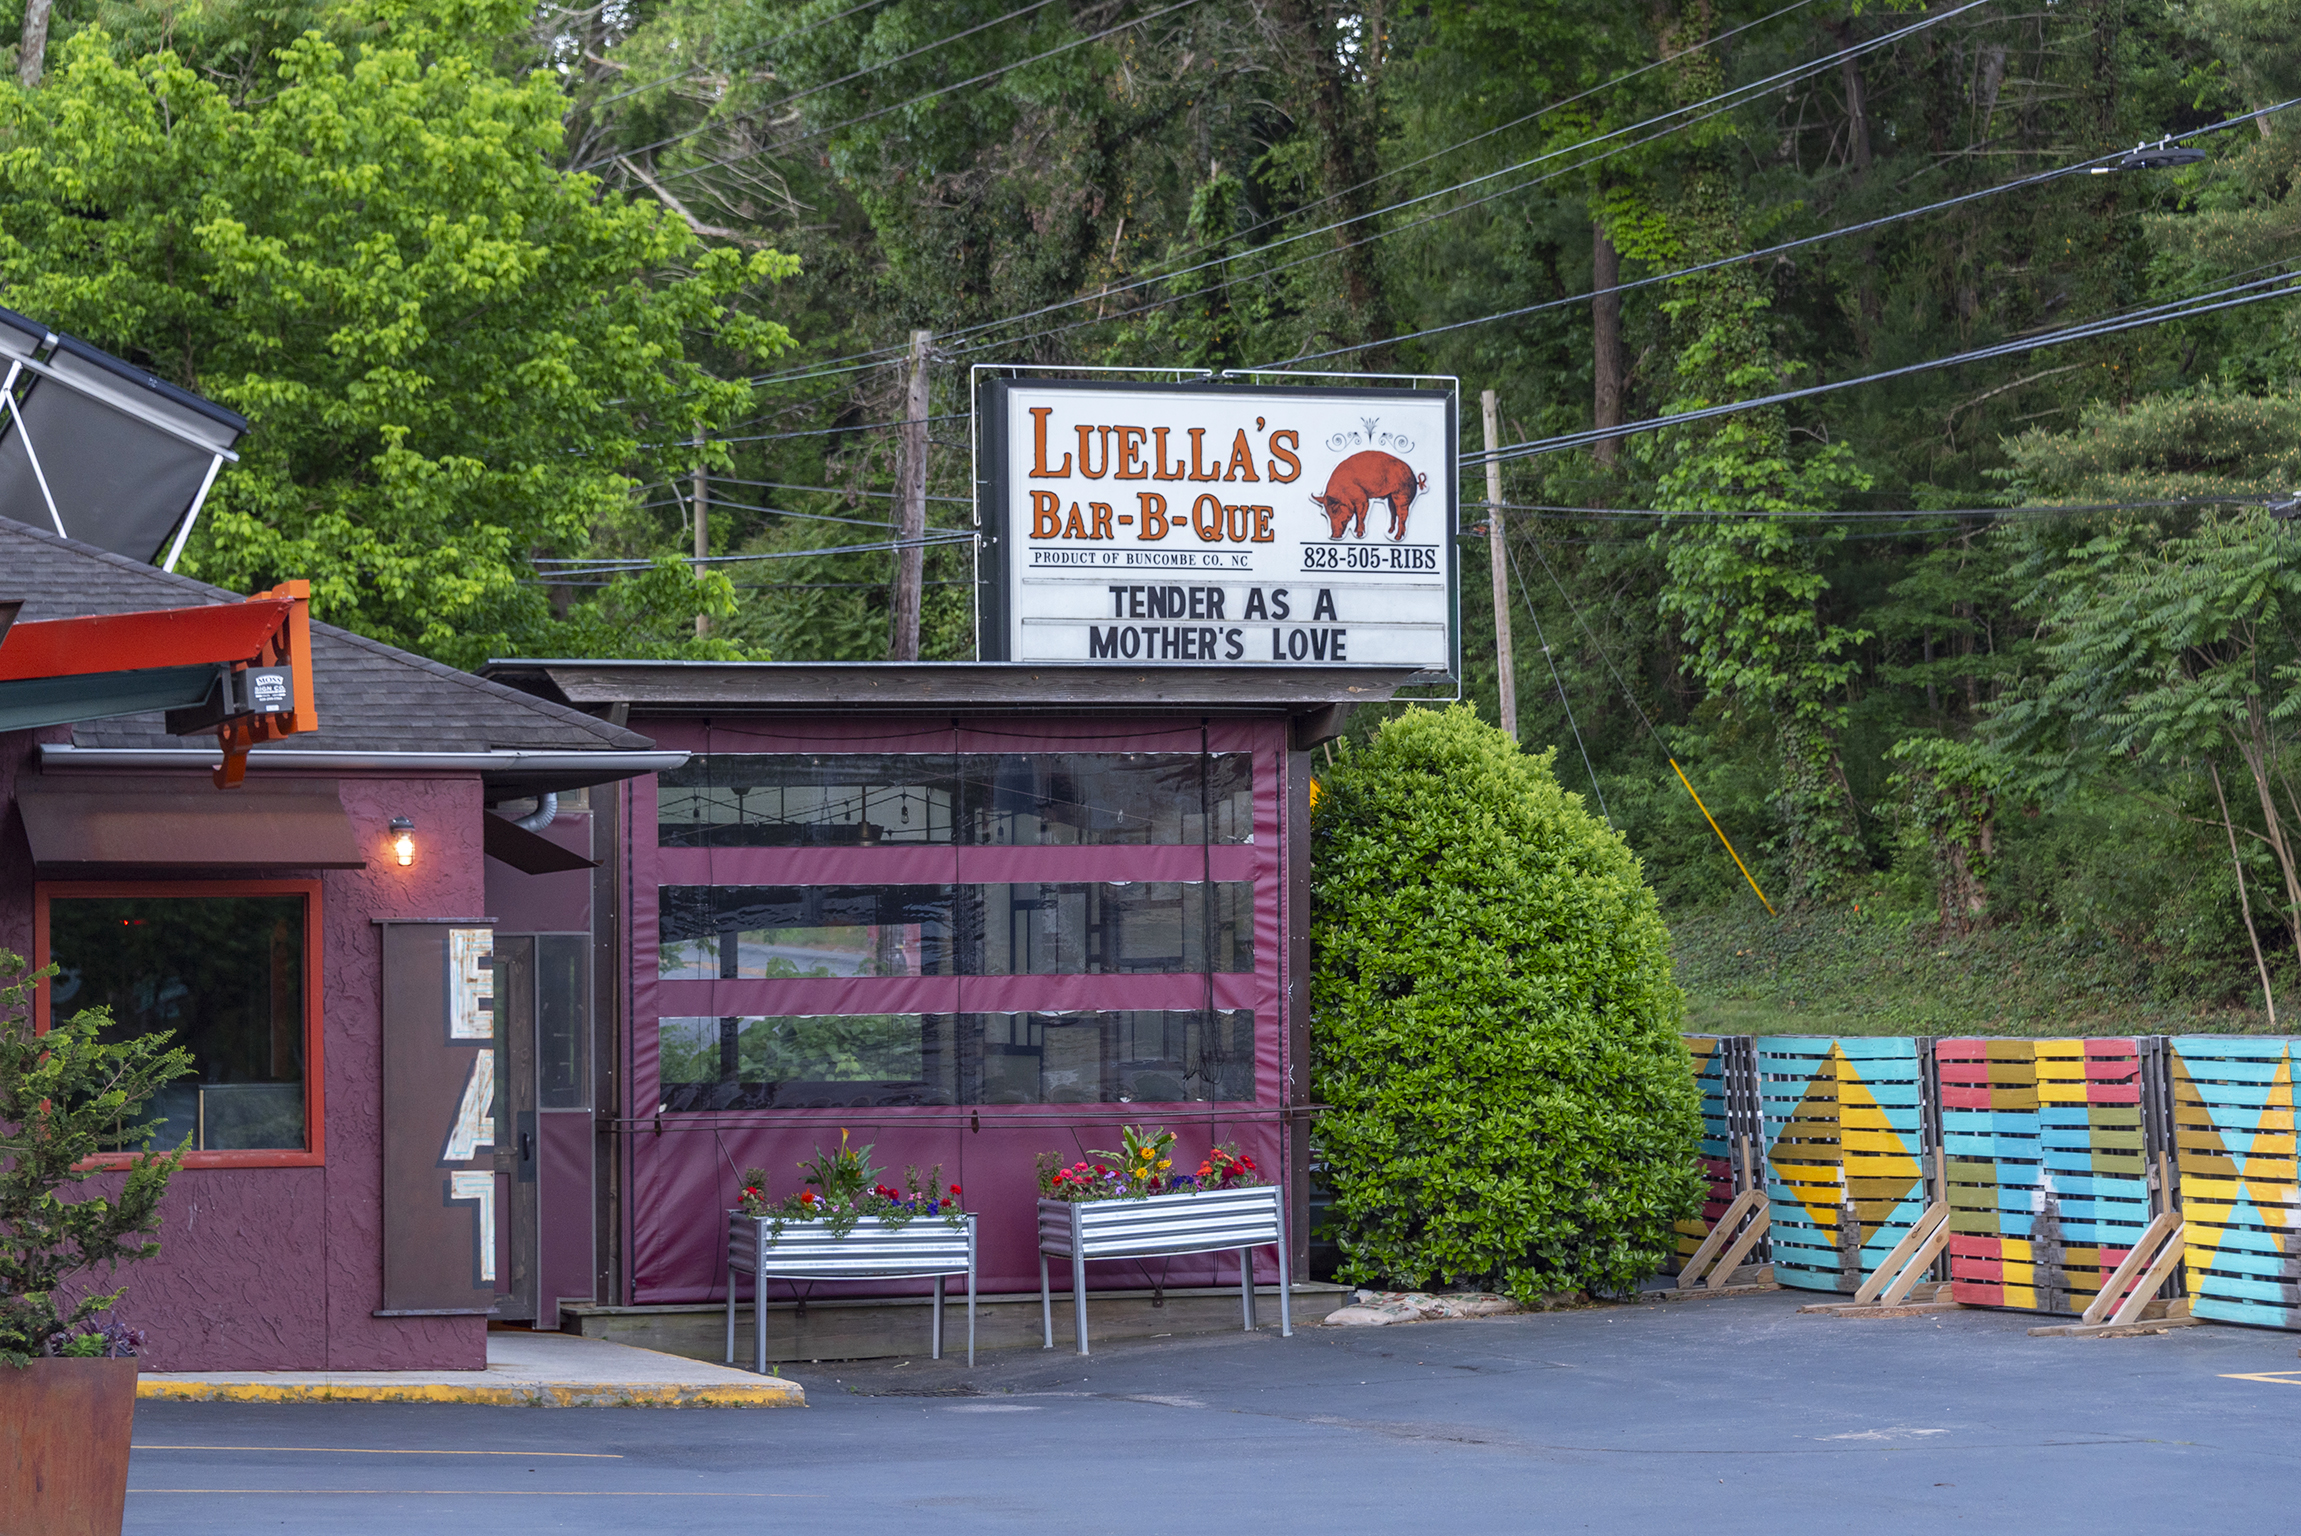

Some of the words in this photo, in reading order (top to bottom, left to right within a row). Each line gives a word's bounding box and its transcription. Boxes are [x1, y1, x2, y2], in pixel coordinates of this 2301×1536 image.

[1029, 407, 1301, 483] LUELLA'S
[1029, 490, 1275, 543] BAR-B-QUE
[1034, 551, 1096, 565] PRODUCT
[1102, 553, 1120, 565] OF
[1126, 553, 1197, 567] BUNCOMBE
[1202, 555, 1224, 567] CO.
[1231, 555, 1249, 568] NC
[1303, 547, 1437, 571] 828-505-RIBS
[1108, 585, 1226, 619] TENDER
[1243, 587, 1290, 621] AS
[1312, 588, 1338, 621] A
[1088, 626, 1244, 661] MOTHER'S
[1272, 629, 1347, 662] LOVE
